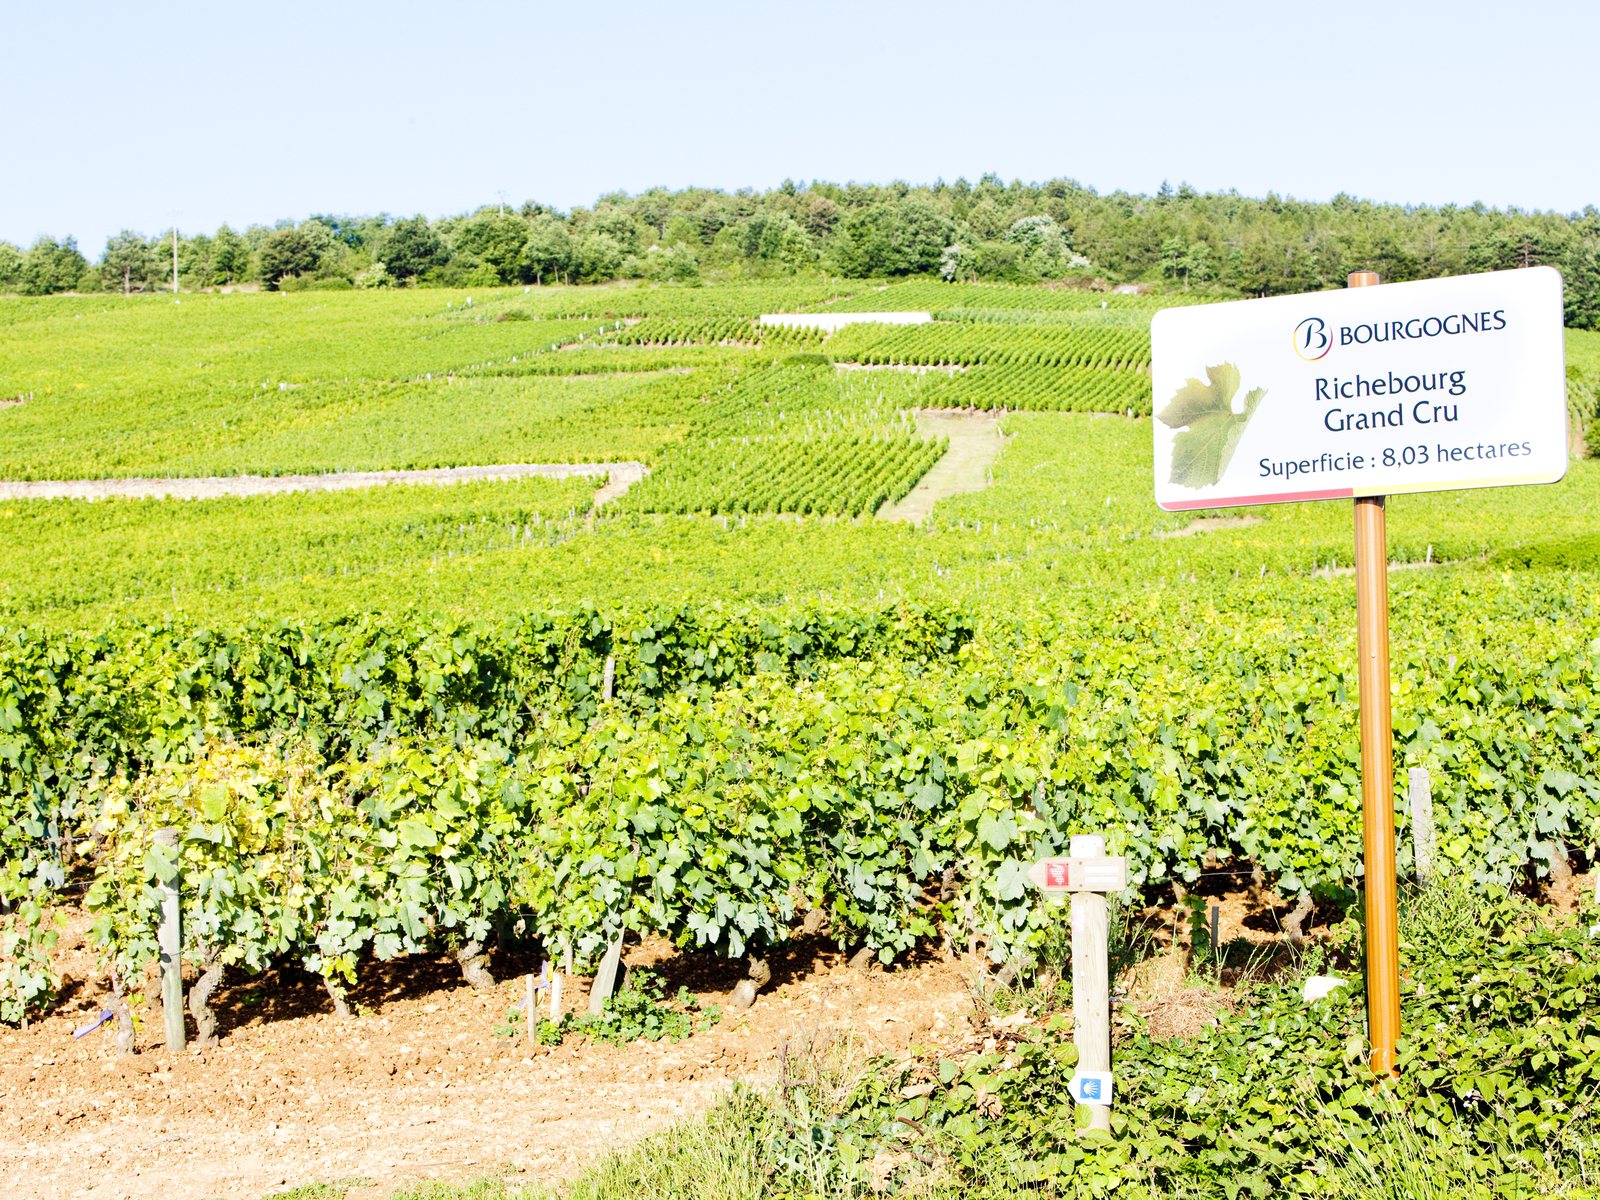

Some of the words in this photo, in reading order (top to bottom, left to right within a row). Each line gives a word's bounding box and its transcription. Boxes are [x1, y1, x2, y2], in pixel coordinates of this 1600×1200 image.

[1340, 309, 1507, 346] BOURGOGNES
[1315, 370, 1467, 400] Richebourg
[1324, 402, 1404, 432] Grand
[1412, 400, 1459, 425] Cru
[1259, 451, 1365, 479] Superficie
[1382, 445, 1430, 468] 8,03
[1436, 441, 1532, 463] hectares
